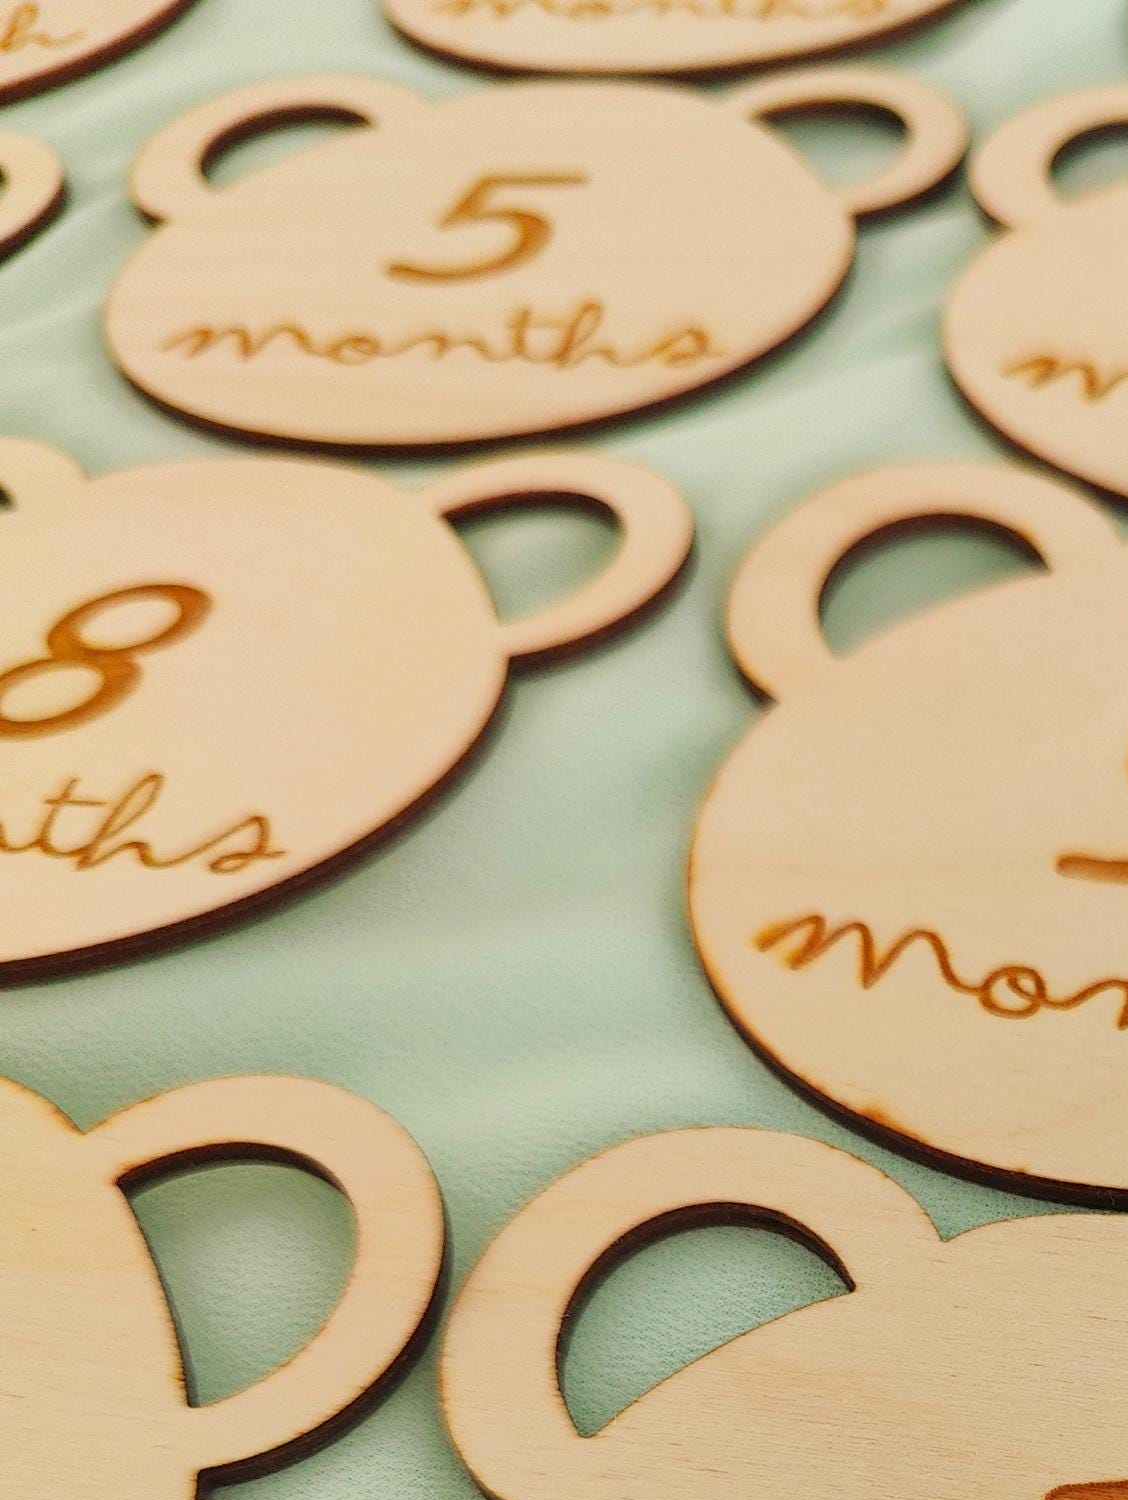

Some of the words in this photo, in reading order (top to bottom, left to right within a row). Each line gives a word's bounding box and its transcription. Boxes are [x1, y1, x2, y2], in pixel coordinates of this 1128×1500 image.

[385, 170, 588, 284] 5
[162, 300, 724, 370] months
[0, 582, 214, 742] 8
[0, 772, 288, 876] ths
